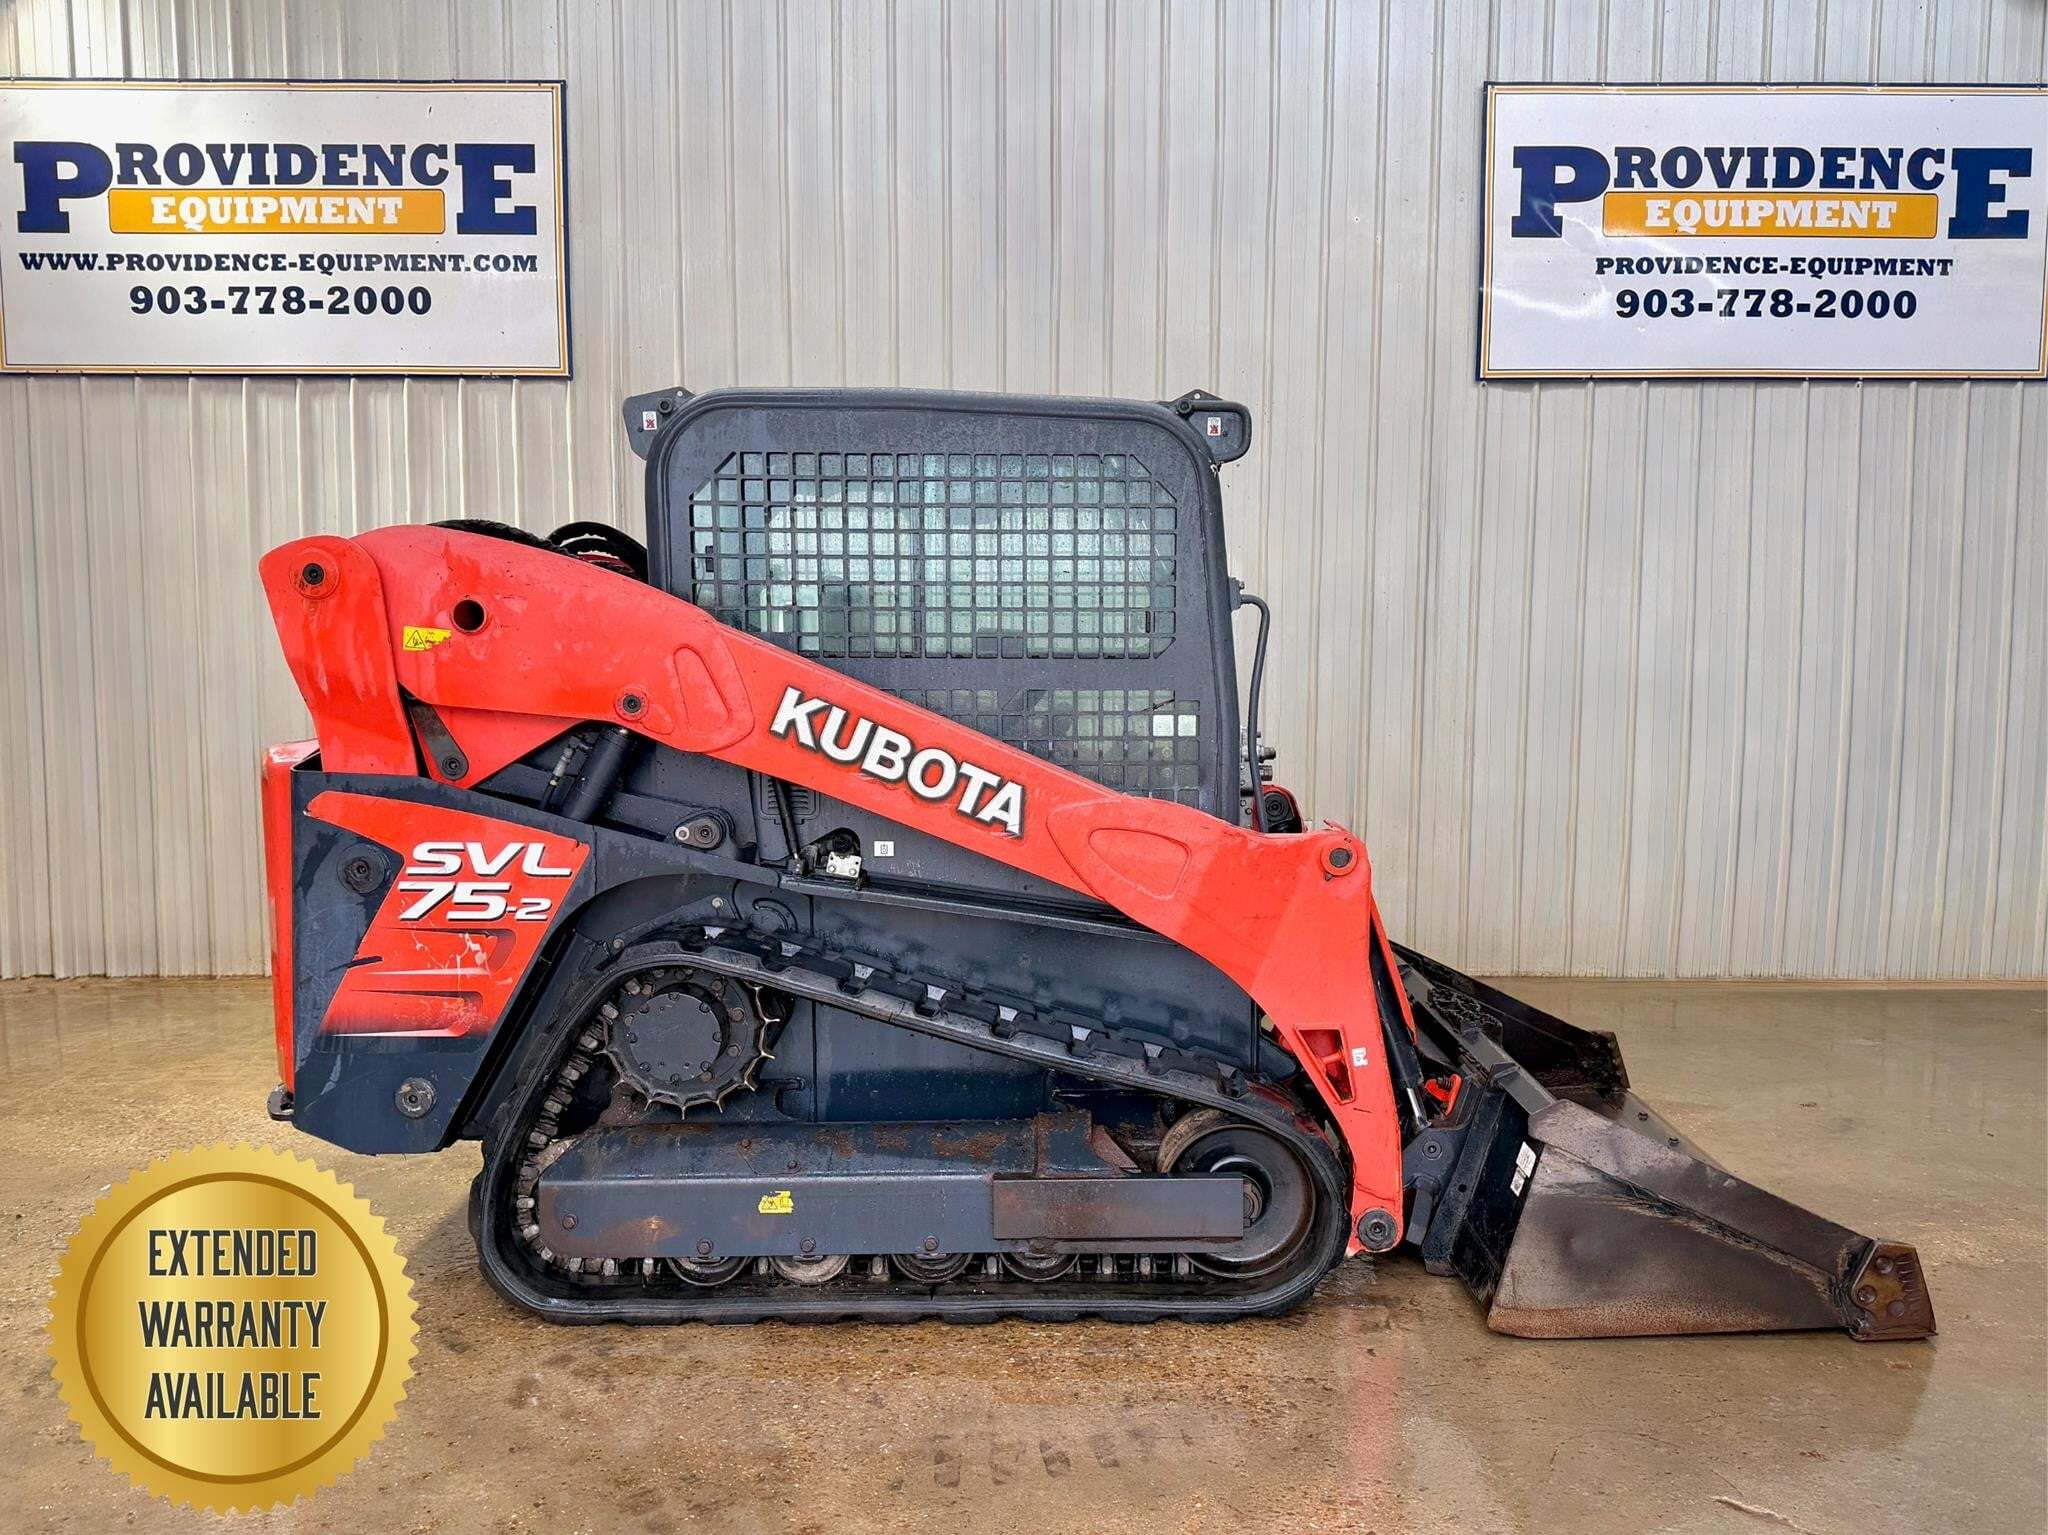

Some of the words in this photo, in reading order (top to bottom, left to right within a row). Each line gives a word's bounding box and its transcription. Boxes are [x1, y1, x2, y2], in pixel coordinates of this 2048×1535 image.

[13, 141, 537, 236] PROVIDENCE
[1511, 145, 2033, 240] PROVIDENCE
[151, 196, 402, 231] EQUIPMENT
[1644, 200, 1898, 235] EQUIPMENT
[18, 252, 538, 275] WWW.PROVIDENCE-EQUIPMENT.COM
[1595, 256, 1954, 280] PROVIDENCE-EQUIPMENT
[129, 285, 432, 315] 903-778-2000
[1615, 289, 1918, 318] 903-778-2000
[769, 685, 1026, 837] KUBOTA
[405, 840, 574, 878] SVL
[398, 880, 553, 922] 75-2
